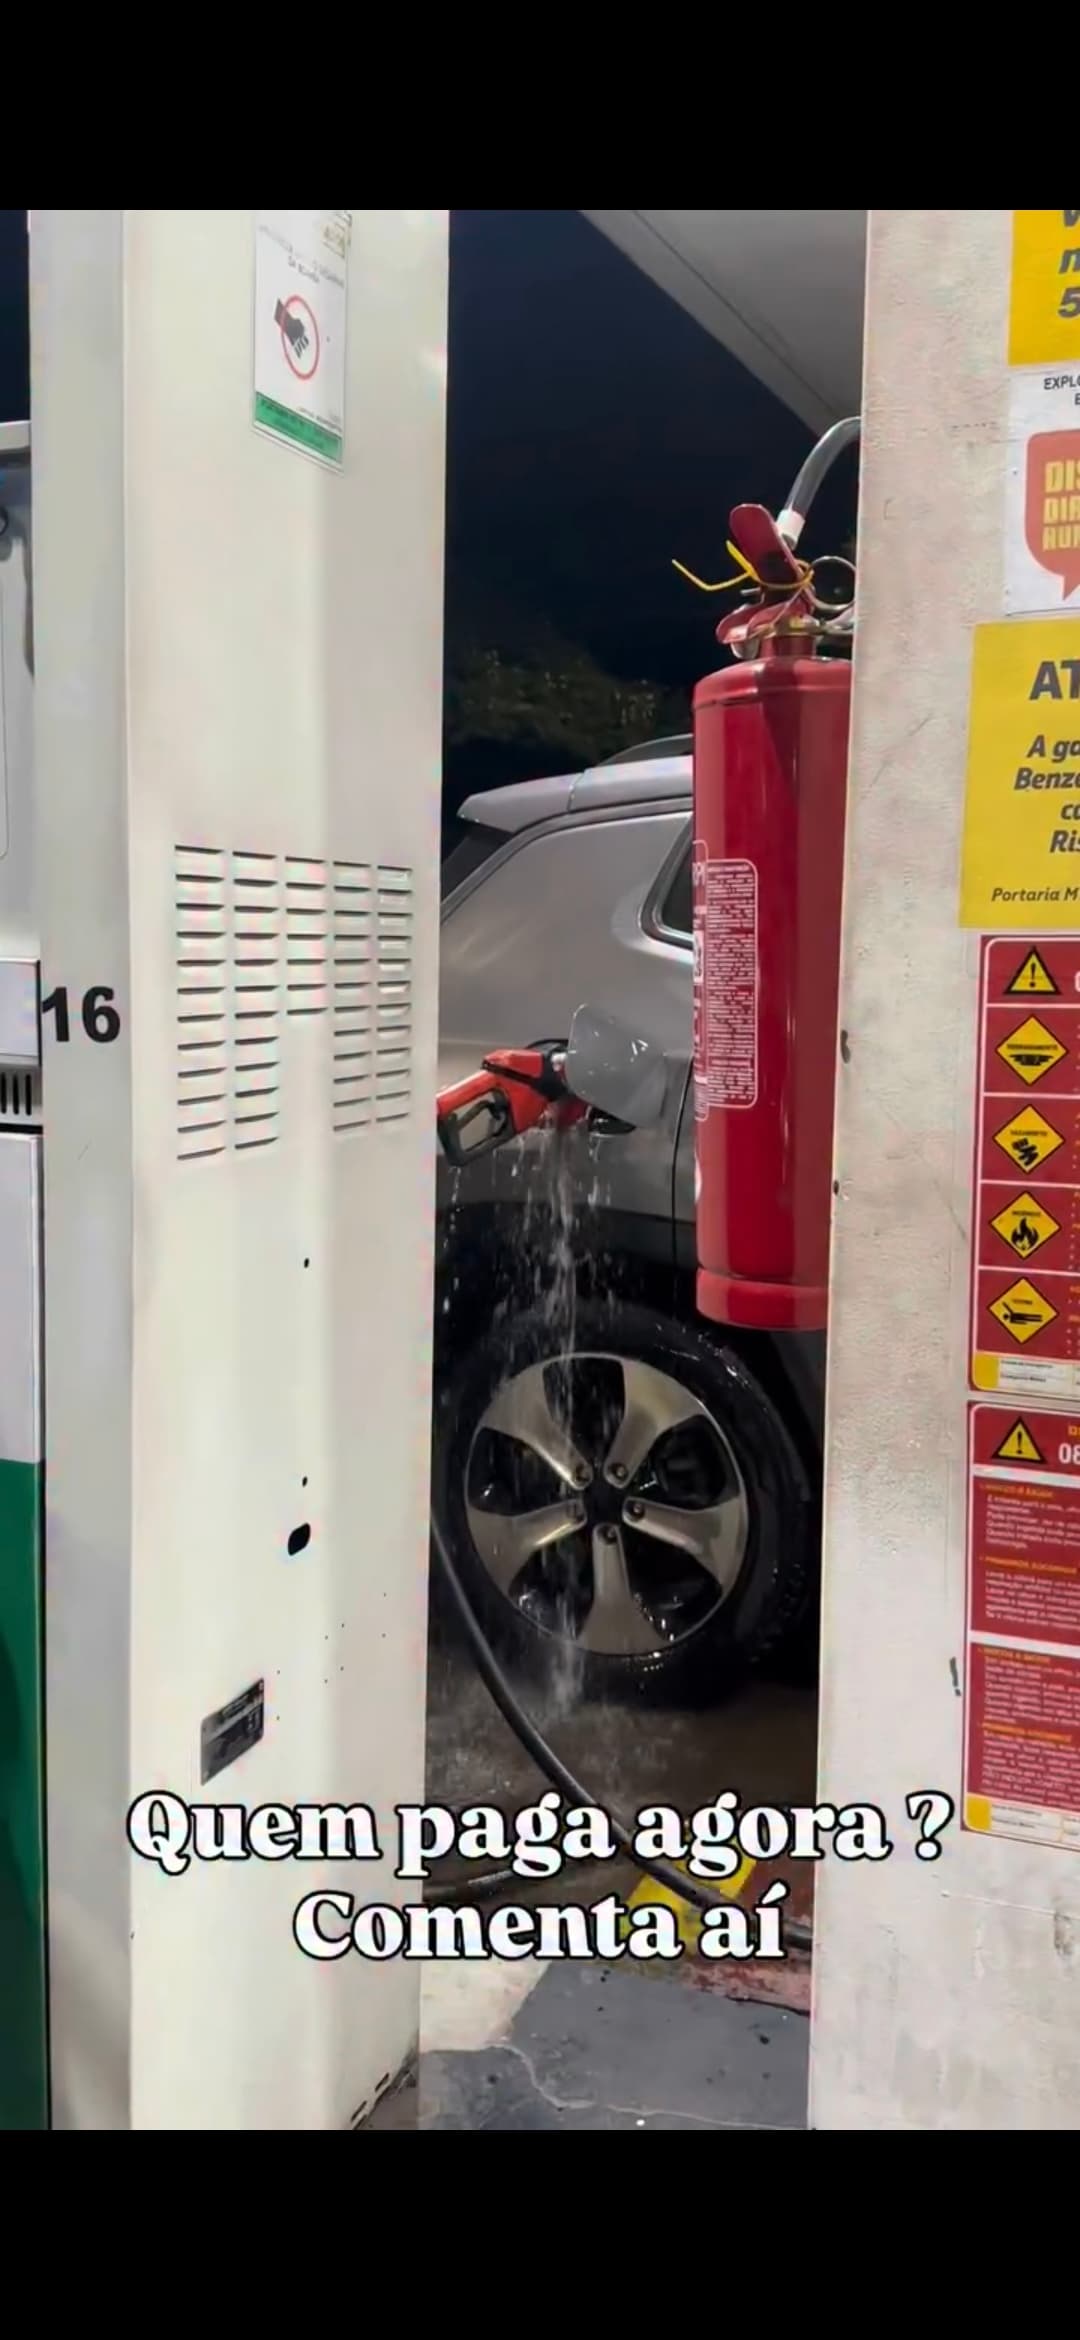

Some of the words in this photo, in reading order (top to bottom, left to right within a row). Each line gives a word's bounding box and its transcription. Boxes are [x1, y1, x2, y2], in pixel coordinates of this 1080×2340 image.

[1026, 734, 1046, 758] A
[991, 887, 1060, 902] Portaria
[41, 986, 121, 1043] 16
